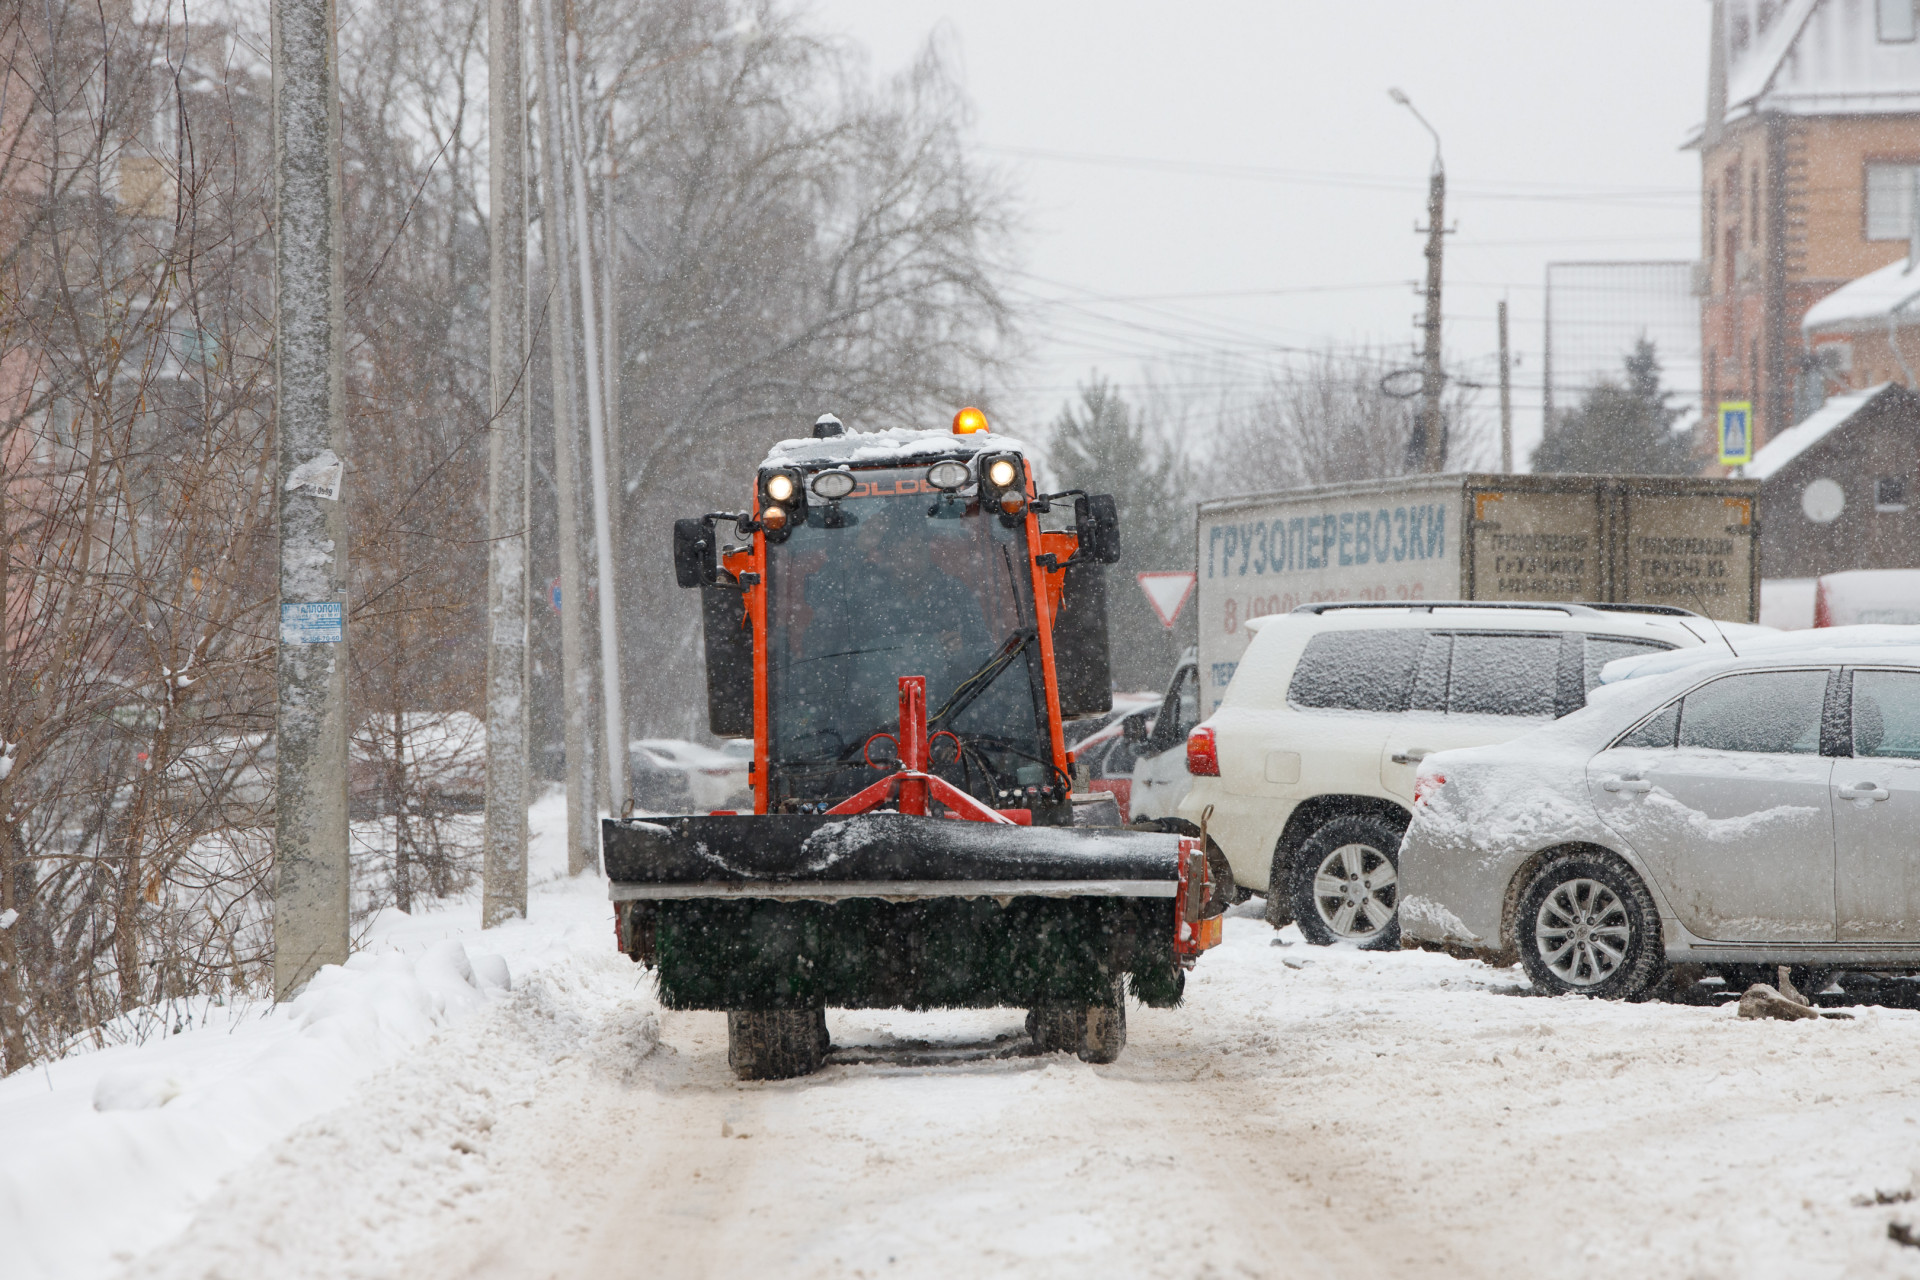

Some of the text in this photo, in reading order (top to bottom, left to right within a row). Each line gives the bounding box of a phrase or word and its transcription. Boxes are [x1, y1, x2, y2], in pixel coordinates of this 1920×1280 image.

[847, 479, 943, 498] OLDE
[1207, 503, 1446, 579] ГРУЗОПЕРЕВОЗКИ
[1495, 556, 1585, 574] ГРУЗЧИКИ
[284, 604, 340, 614] МАЛЛОЛОМ
[1224, 598, 1238, 635] 8
